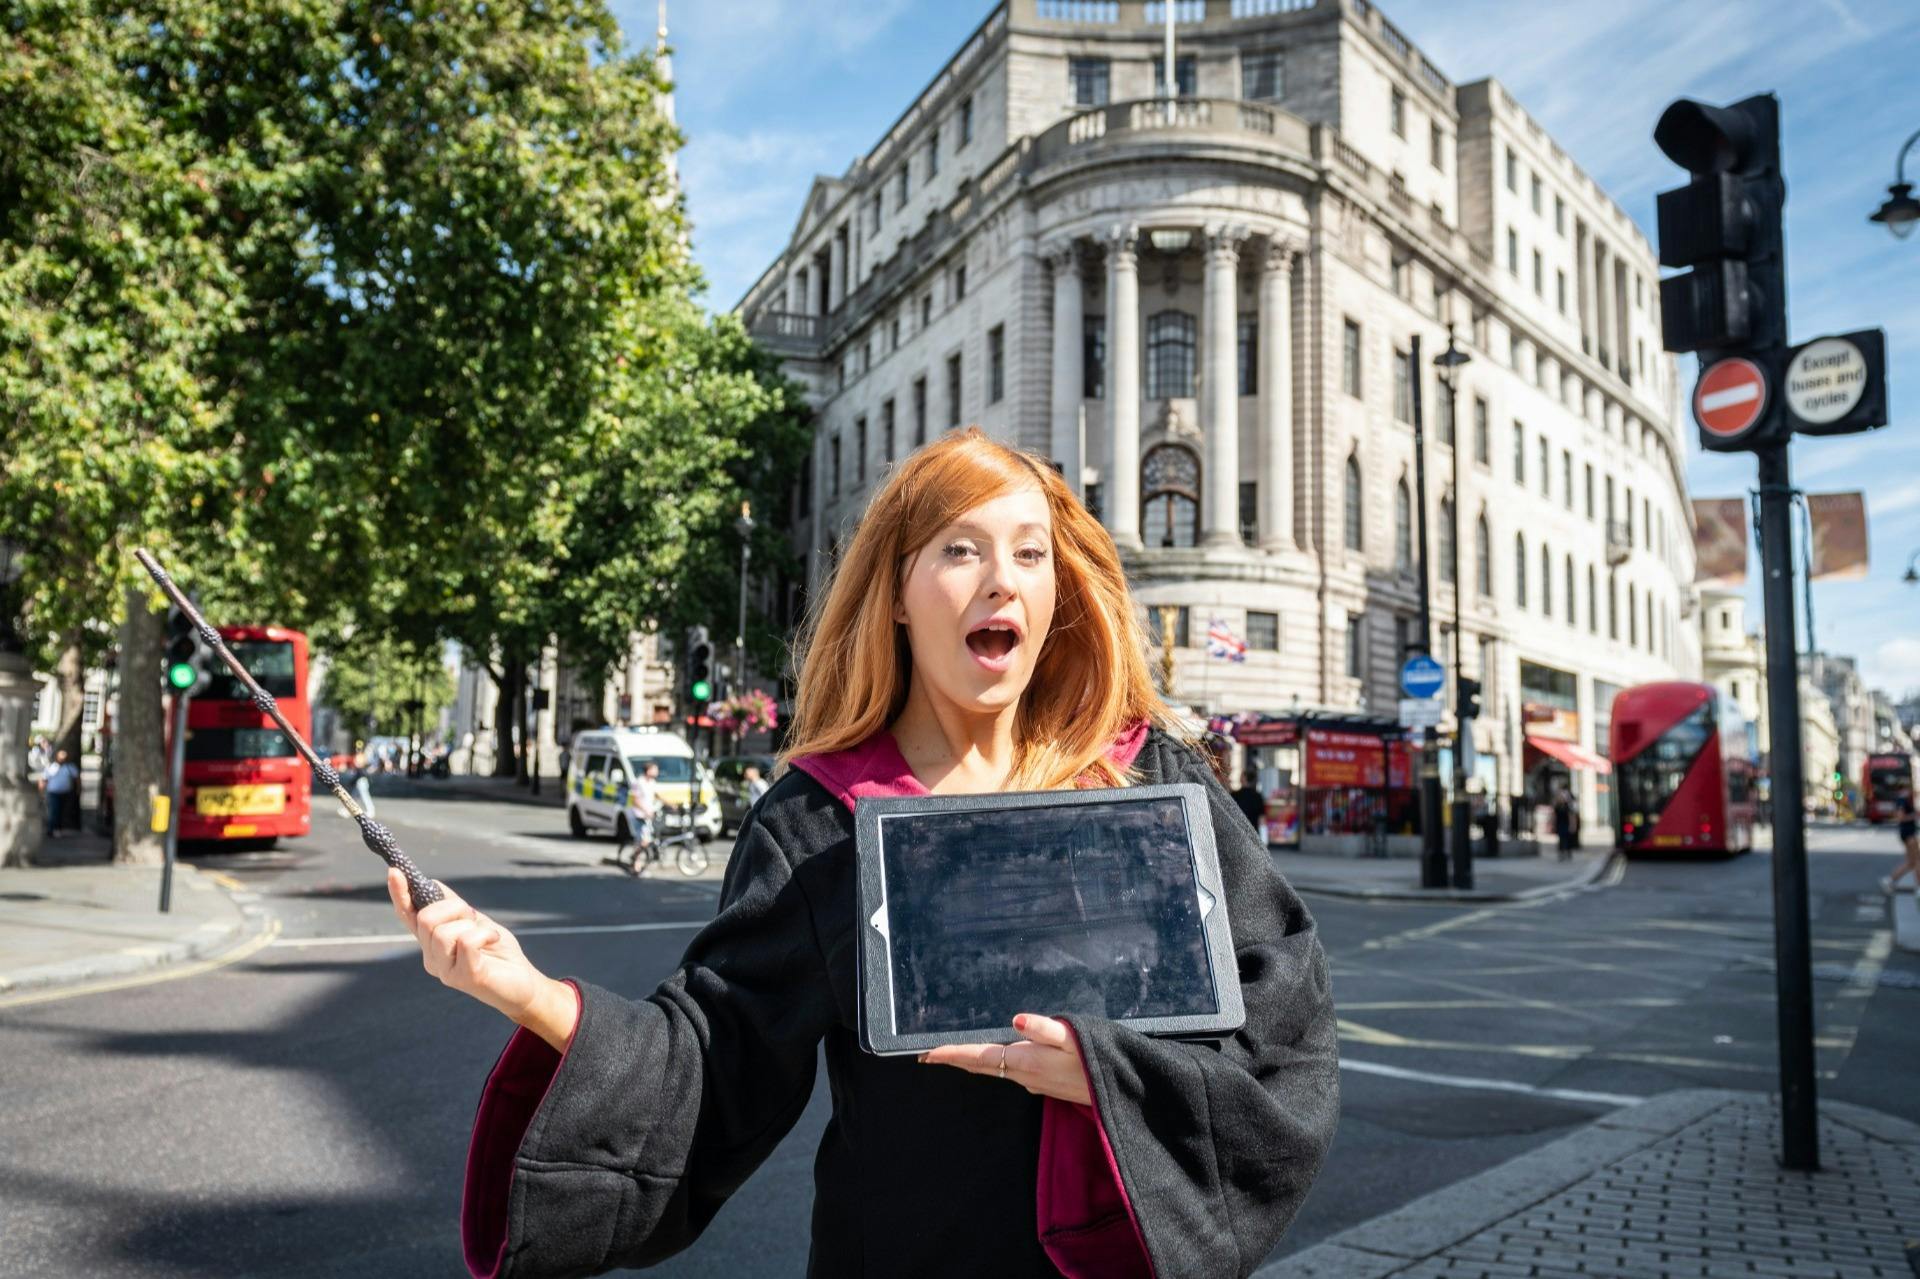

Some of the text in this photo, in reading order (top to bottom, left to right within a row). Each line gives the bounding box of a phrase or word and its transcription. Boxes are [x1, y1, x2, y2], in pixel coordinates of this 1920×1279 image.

[1803, 350, 1849, 372] Except
[1791, 367, 1863, 393] buses and
[1805, 392, 1847, 411] cycles
